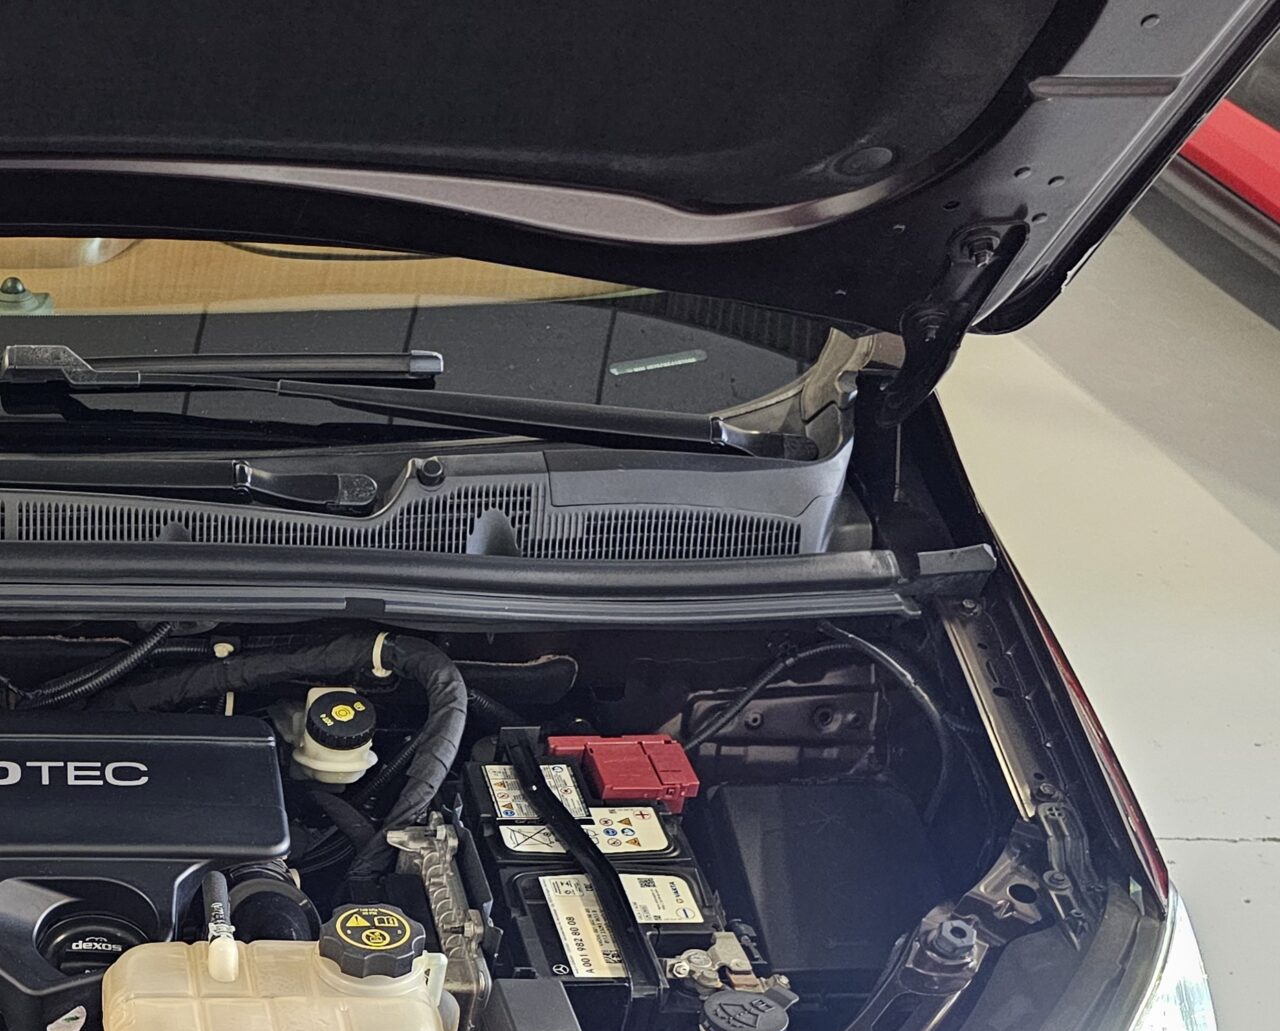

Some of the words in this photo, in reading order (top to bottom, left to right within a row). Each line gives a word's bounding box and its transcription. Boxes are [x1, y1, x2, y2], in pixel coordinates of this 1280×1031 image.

[570, 927, 580, 936] 80
[71, 940, 123, 952] dexos
[574, 937, 586, 951] 982
[580, 954, 592, 967] 001
